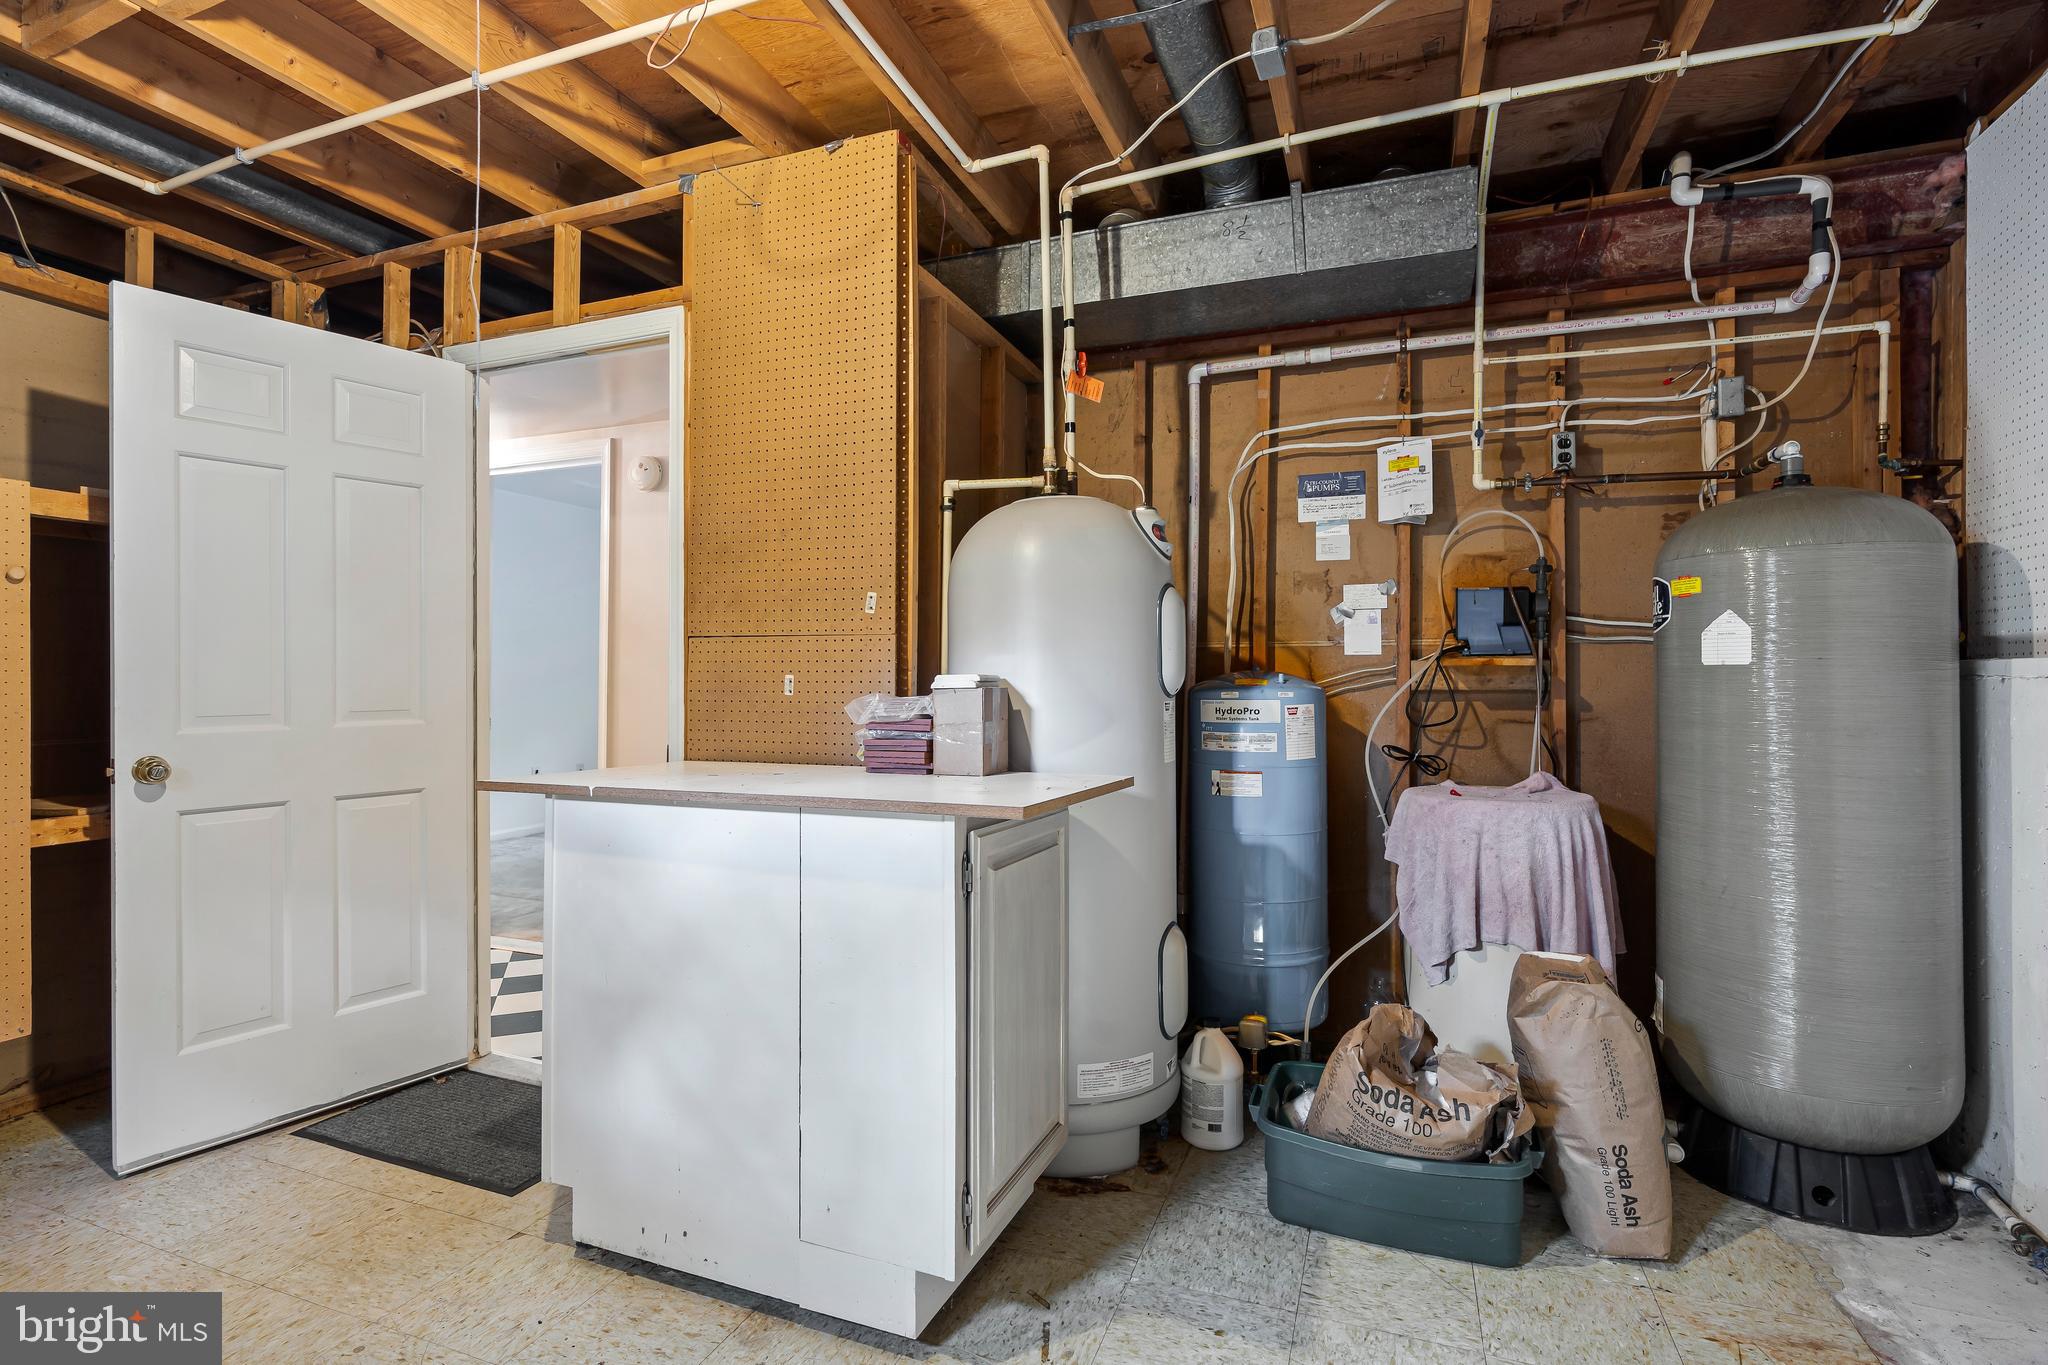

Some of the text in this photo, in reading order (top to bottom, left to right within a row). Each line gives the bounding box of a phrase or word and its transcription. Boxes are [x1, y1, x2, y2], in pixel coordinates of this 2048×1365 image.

[1312, 484, 1340, 492] PUMPS
[1215, 707, 1260, 716] HydroPro
[1351, 1088, 1433, 1138] Grade 100
[1356, 1071, 1413, 1115] Soda
[1420, 1098, 1471, 1122] Ash
[1346, 1101, 1413, 1142] HAZARD STATEMENT
[1597, 1147, 1620, 1226] Grade 100 Light
[1612, 1144, 1634, 1190] Soda
[1621, 1193, 1641, 1227] Ash
